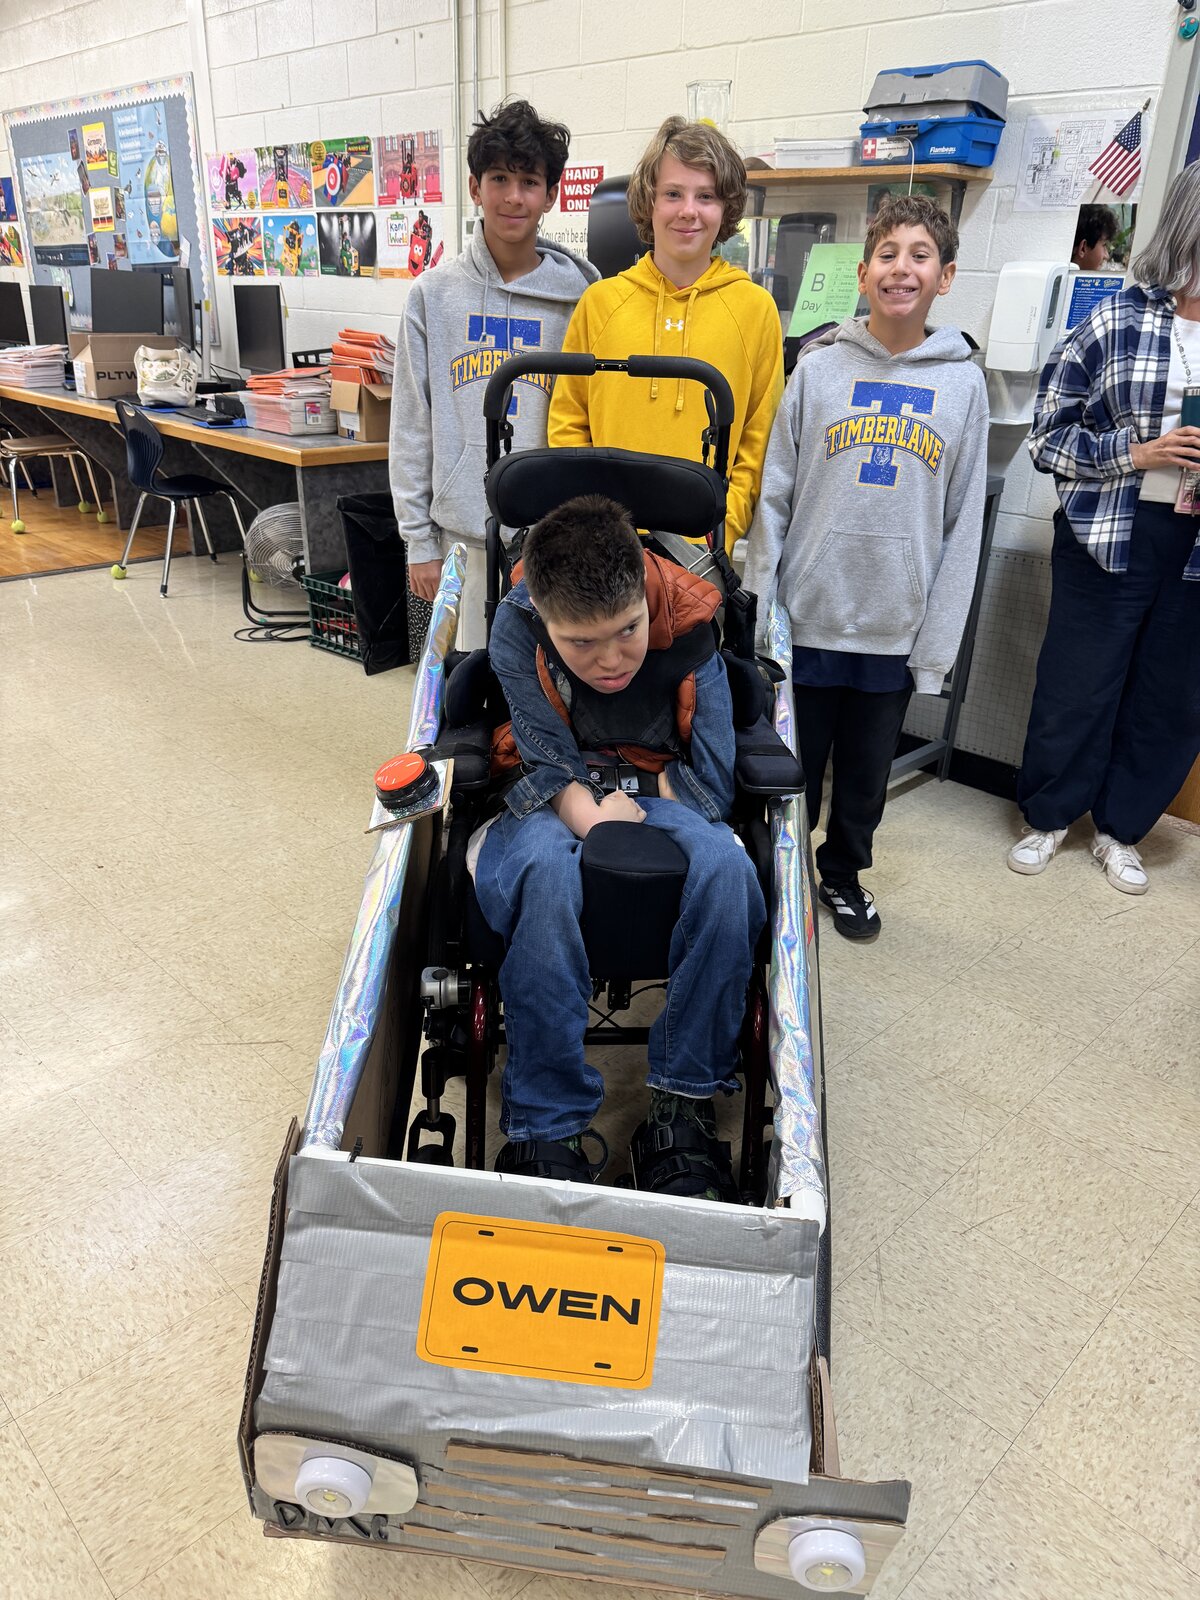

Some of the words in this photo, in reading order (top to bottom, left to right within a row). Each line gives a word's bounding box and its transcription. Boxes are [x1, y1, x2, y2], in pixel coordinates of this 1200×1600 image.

[565, 168, 599, 181] HAND
[567, 199, 591, 211] ONL
[541, 228, 554, 240] You
[554, 228, 569, 243] can't
[571, 228, 579, 243] be
[811, 273, 826, 292] B
[801, 300, 822, 313] Day
[96, 371, 137, 380] PLTW
[825, 413, 946, 474] TIMBERLANE
[453, 1277, 641, 1326] OWEN
